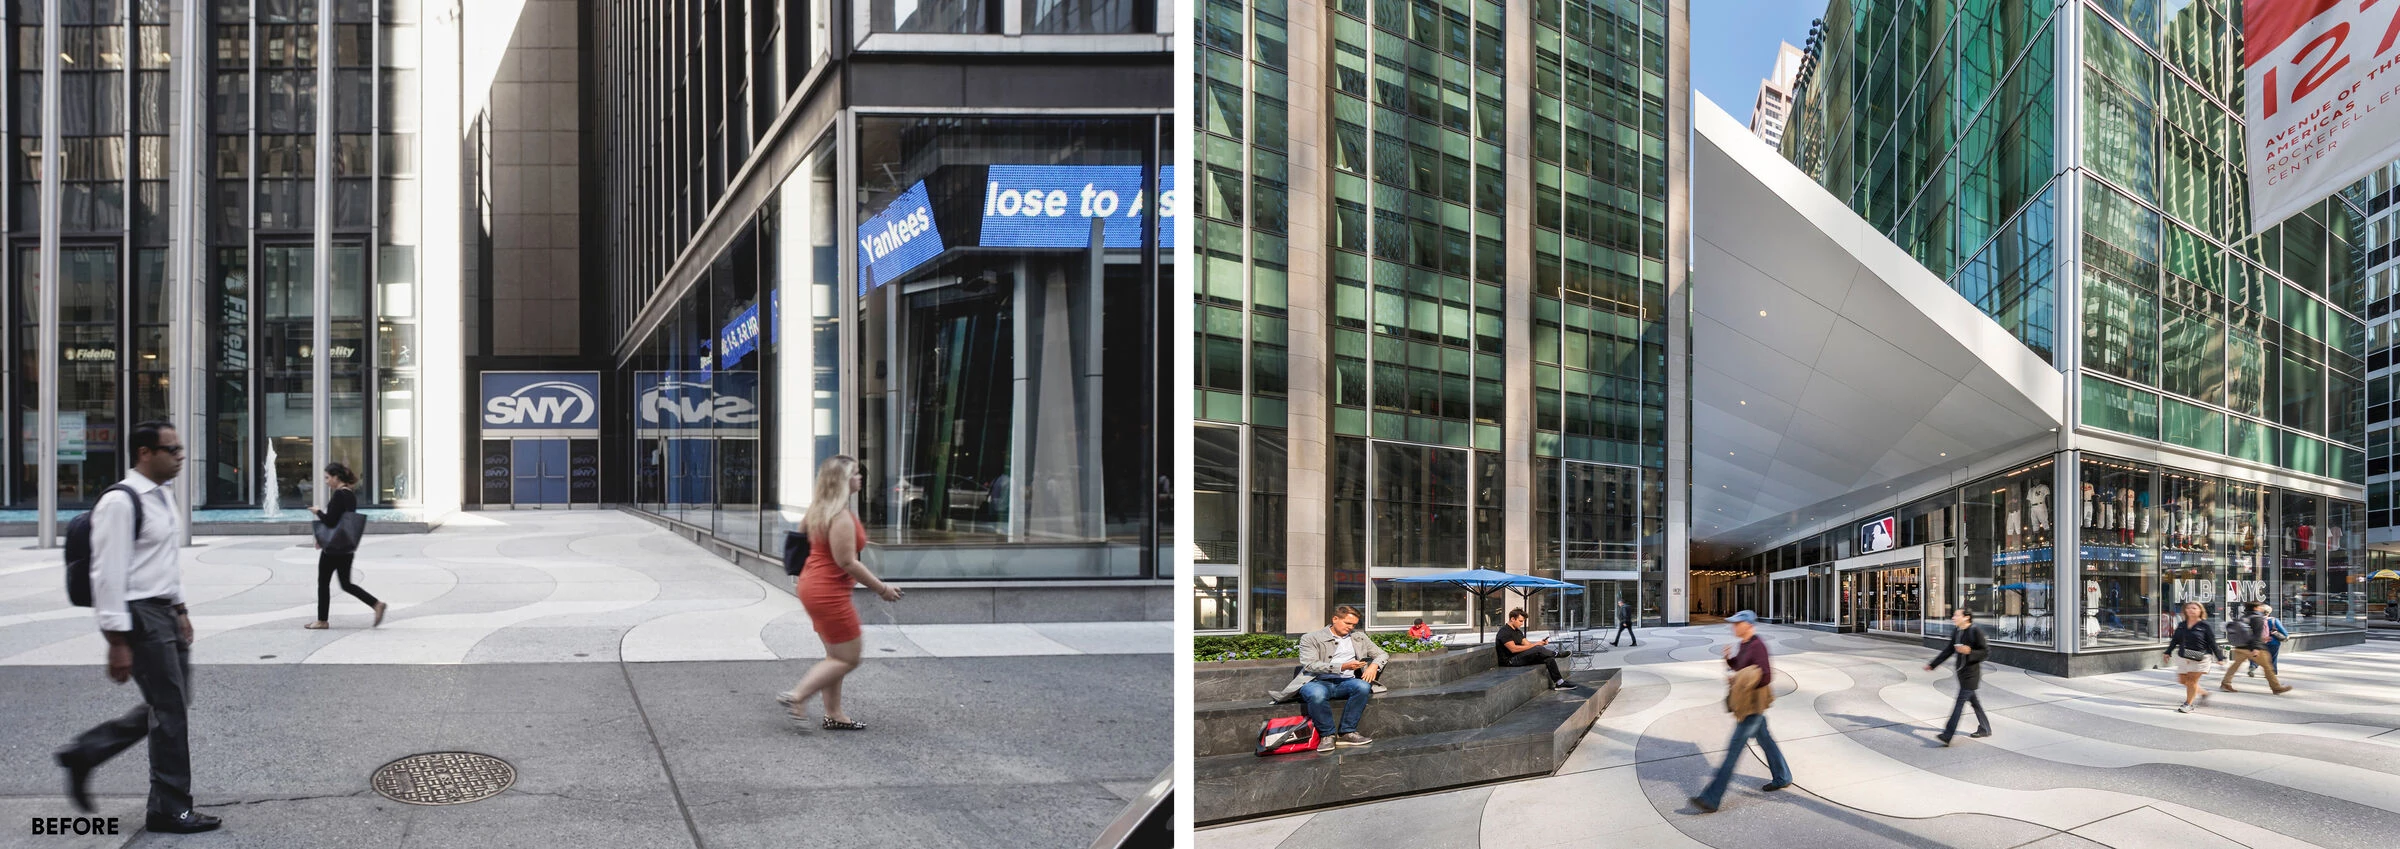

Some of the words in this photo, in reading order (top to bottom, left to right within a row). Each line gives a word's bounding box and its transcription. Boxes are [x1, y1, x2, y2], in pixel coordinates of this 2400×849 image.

[2263, 0, 2400, 120] 127
[2265, 100, 2331, 148] AVENUE
[2337, 80, 2361, 102] OF
[2367, 53, 2400, 80] THE
[2265, 100, 2355, 161] AMERICAS
[2268, 140, 2337, 186] CENTER
[986, 181, 1068, 218] lose
[1079, 182, 1119, 218] to
[861, 205, 929, 264] Yankees
[484, 395, 578, 424] SNY
[2174, 579, 2213, 604] MLB
[2236, 580, 2267, 603] NYC
